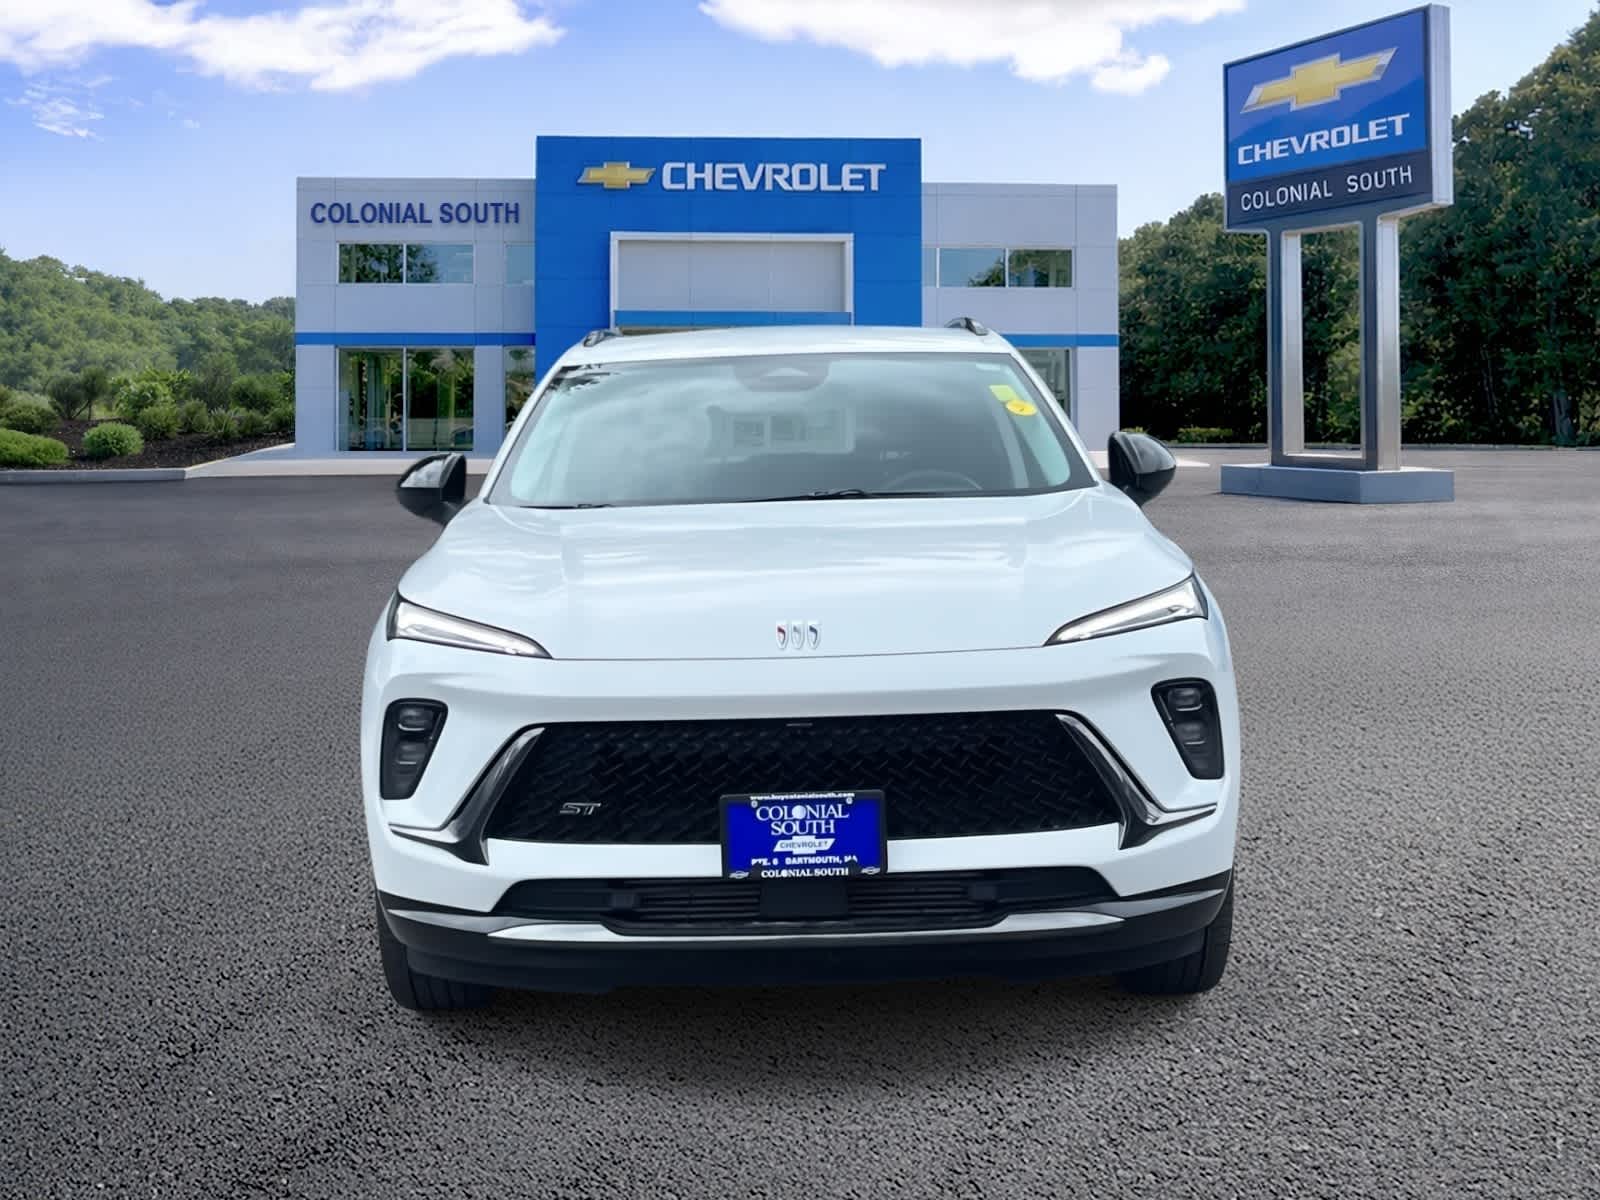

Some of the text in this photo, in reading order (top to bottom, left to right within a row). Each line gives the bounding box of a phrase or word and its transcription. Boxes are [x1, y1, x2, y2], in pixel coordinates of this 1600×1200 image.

[1237, 113, 1410, 165] CHEVROLET
[662, 162, 887, 192] CHEVROLET
[1240, 165, 1413, 211] COLONIAL SOUTH
[310, 202, 520, 224] COLONIAL SOUTH
[559, 802, 602, 815] ST
[755, 803, 850, 821] COLONIAL
[770, 819, 836, 836] SOUTH
[779, 840, 828, 849] CHEVROLET
[761, 867, 849, 878] COLONIAL SOUTH
